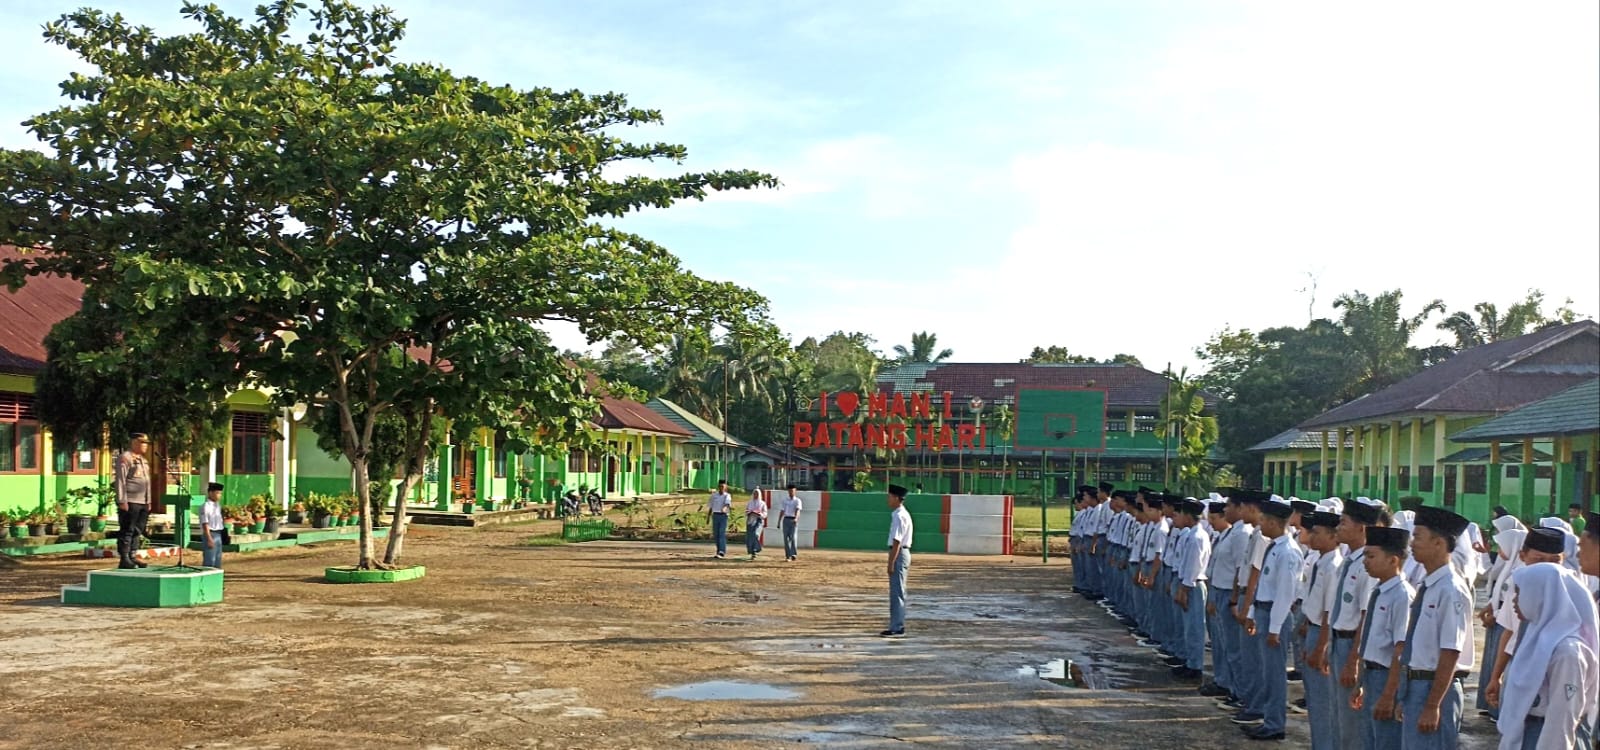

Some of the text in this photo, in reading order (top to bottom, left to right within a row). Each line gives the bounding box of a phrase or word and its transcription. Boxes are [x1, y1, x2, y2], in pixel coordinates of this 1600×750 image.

[820, 391, 828, 417] I
[869, 391, 930, 418] MAN
[793, 422, 987, 450] BATANG HARI
